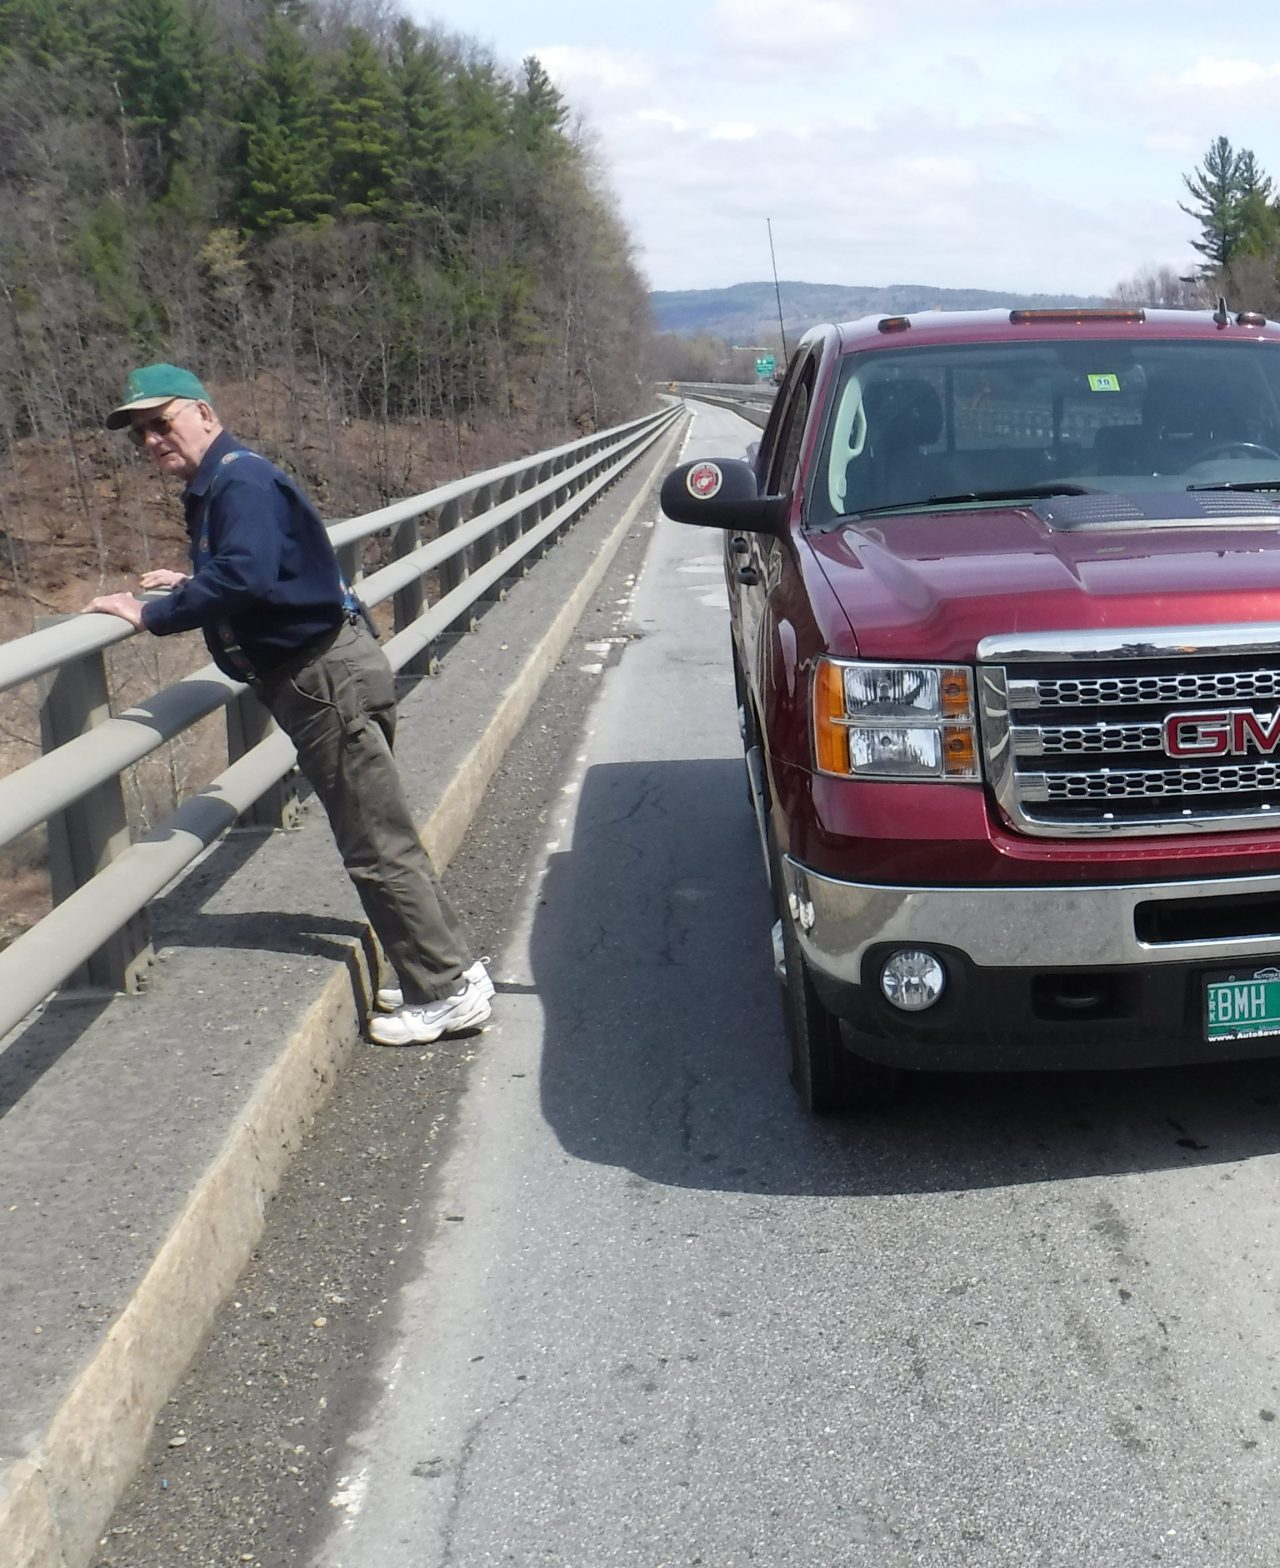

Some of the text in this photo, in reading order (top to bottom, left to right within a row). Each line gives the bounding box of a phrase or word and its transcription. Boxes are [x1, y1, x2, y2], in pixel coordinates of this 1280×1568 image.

[1208, 989, 1216, 1022] TRK
[1218, 985, 1266, 1021] BMH
[1207, 1034, 1236, 1042] www.
